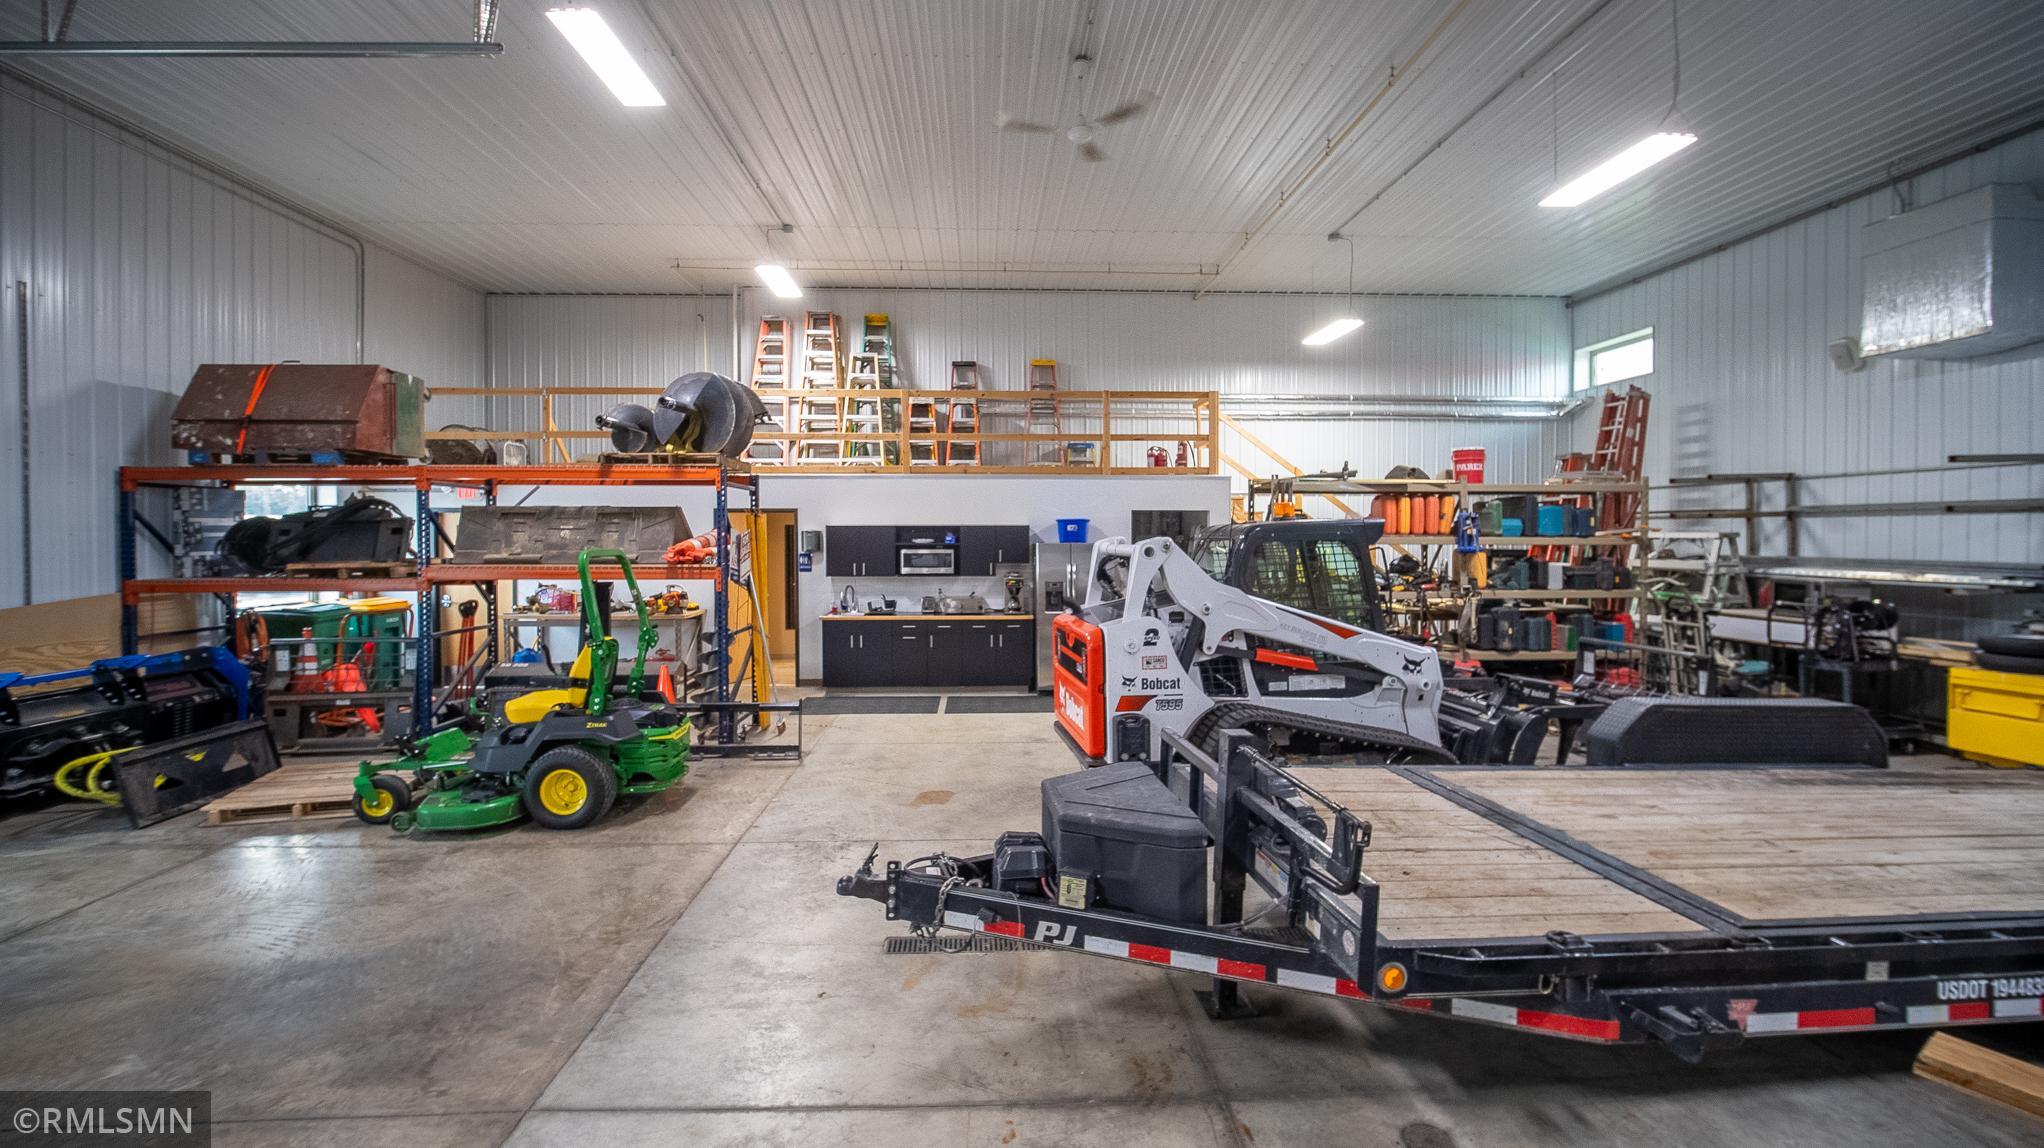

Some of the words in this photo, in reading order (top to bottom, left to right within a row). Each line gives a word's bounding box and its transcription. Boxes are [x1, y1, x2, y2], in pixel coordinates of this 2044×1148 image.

[1141, 677, 1181, 690] Bobcat
[1155, 699, 1184, 711] T595
[1033, 920, 1077, 946] PJ
[1937, 979, 1989, 1000] USDOT
